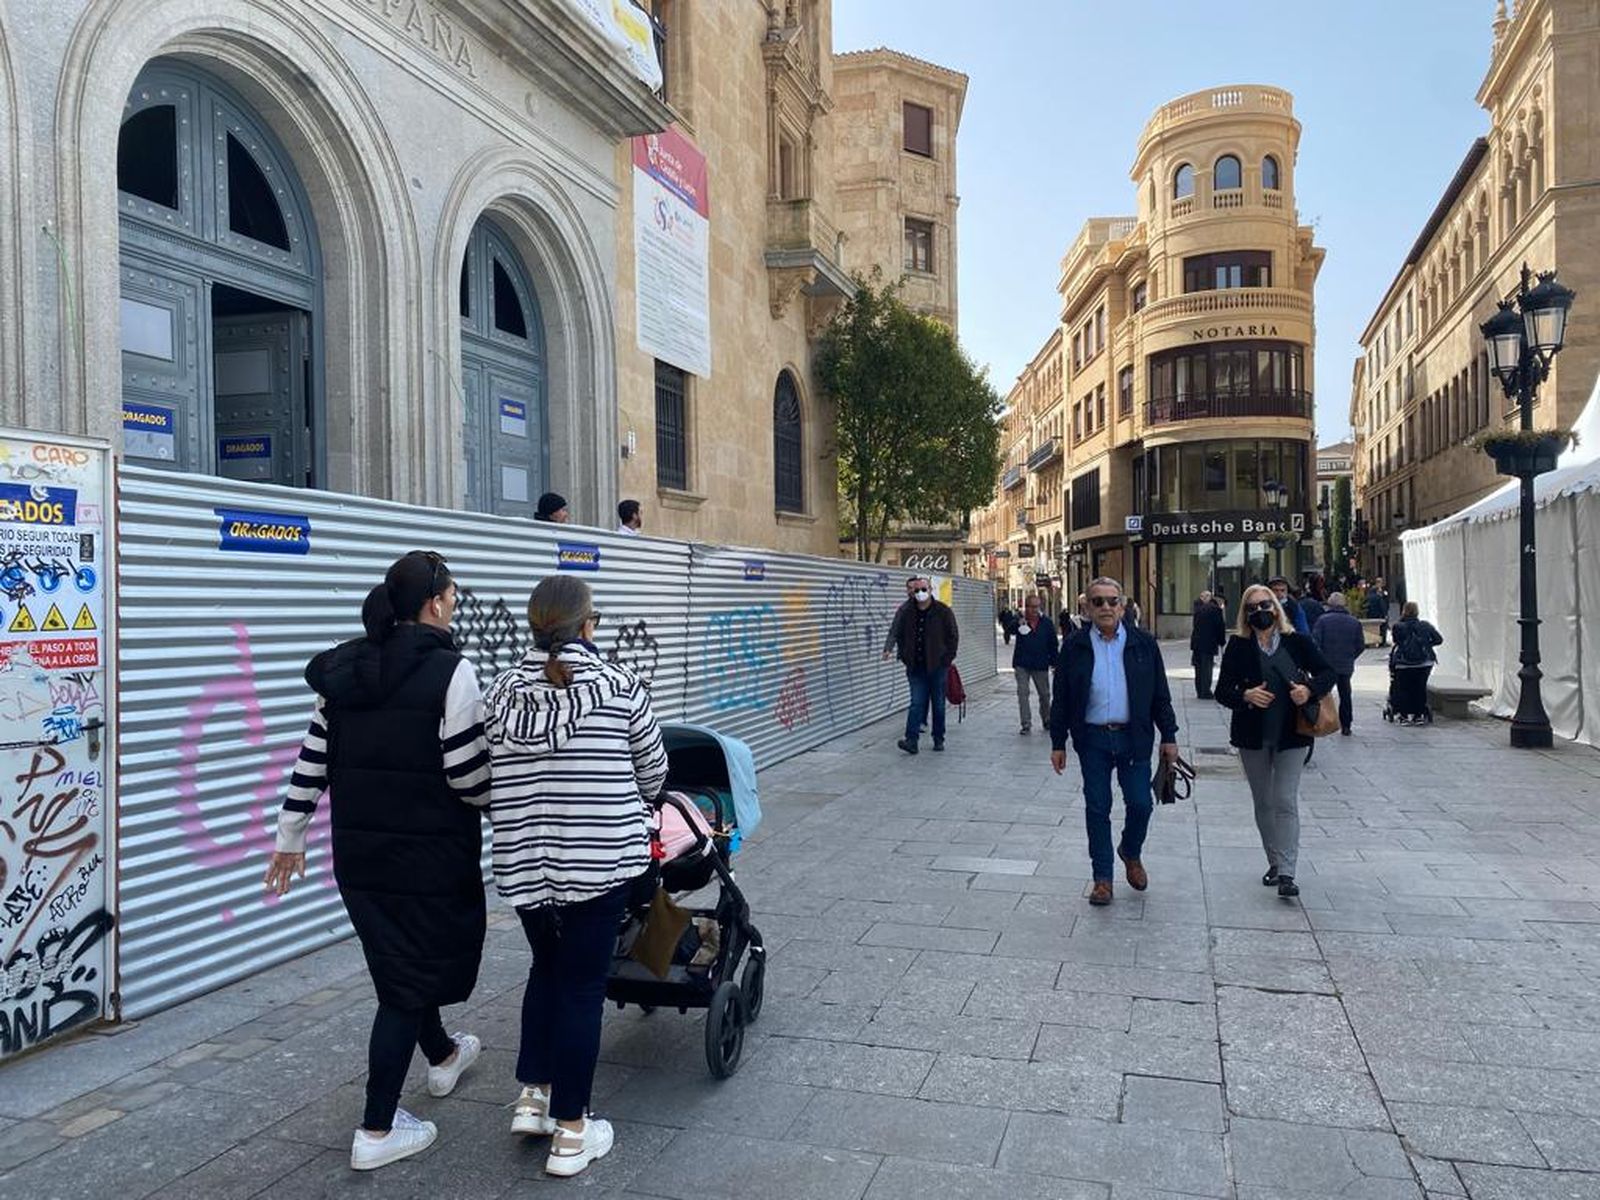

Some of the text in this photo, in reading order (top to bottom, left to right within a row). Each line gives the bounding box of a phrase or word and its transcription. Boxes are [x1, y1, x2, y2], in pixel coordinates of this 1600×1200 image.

[1193, 323, 1278, 340] NOTARÍA
[123, 411, 167, 426] DRAGADOS
[230, 522, 302, 541] DRAGADOS
[1152, 520, 1235, 535] Deutsche
[17, 530, 49, 542] SEGUIR
[23, 544, 73, 557] SEGURIDAD
[41, 642, 65, 653] PASO
[65, 642, 73, 652] A
[74, 640, 96, 651] TODA
[59, 655, 72, 665] LA
[72, 653, 96, 664] OBRA
